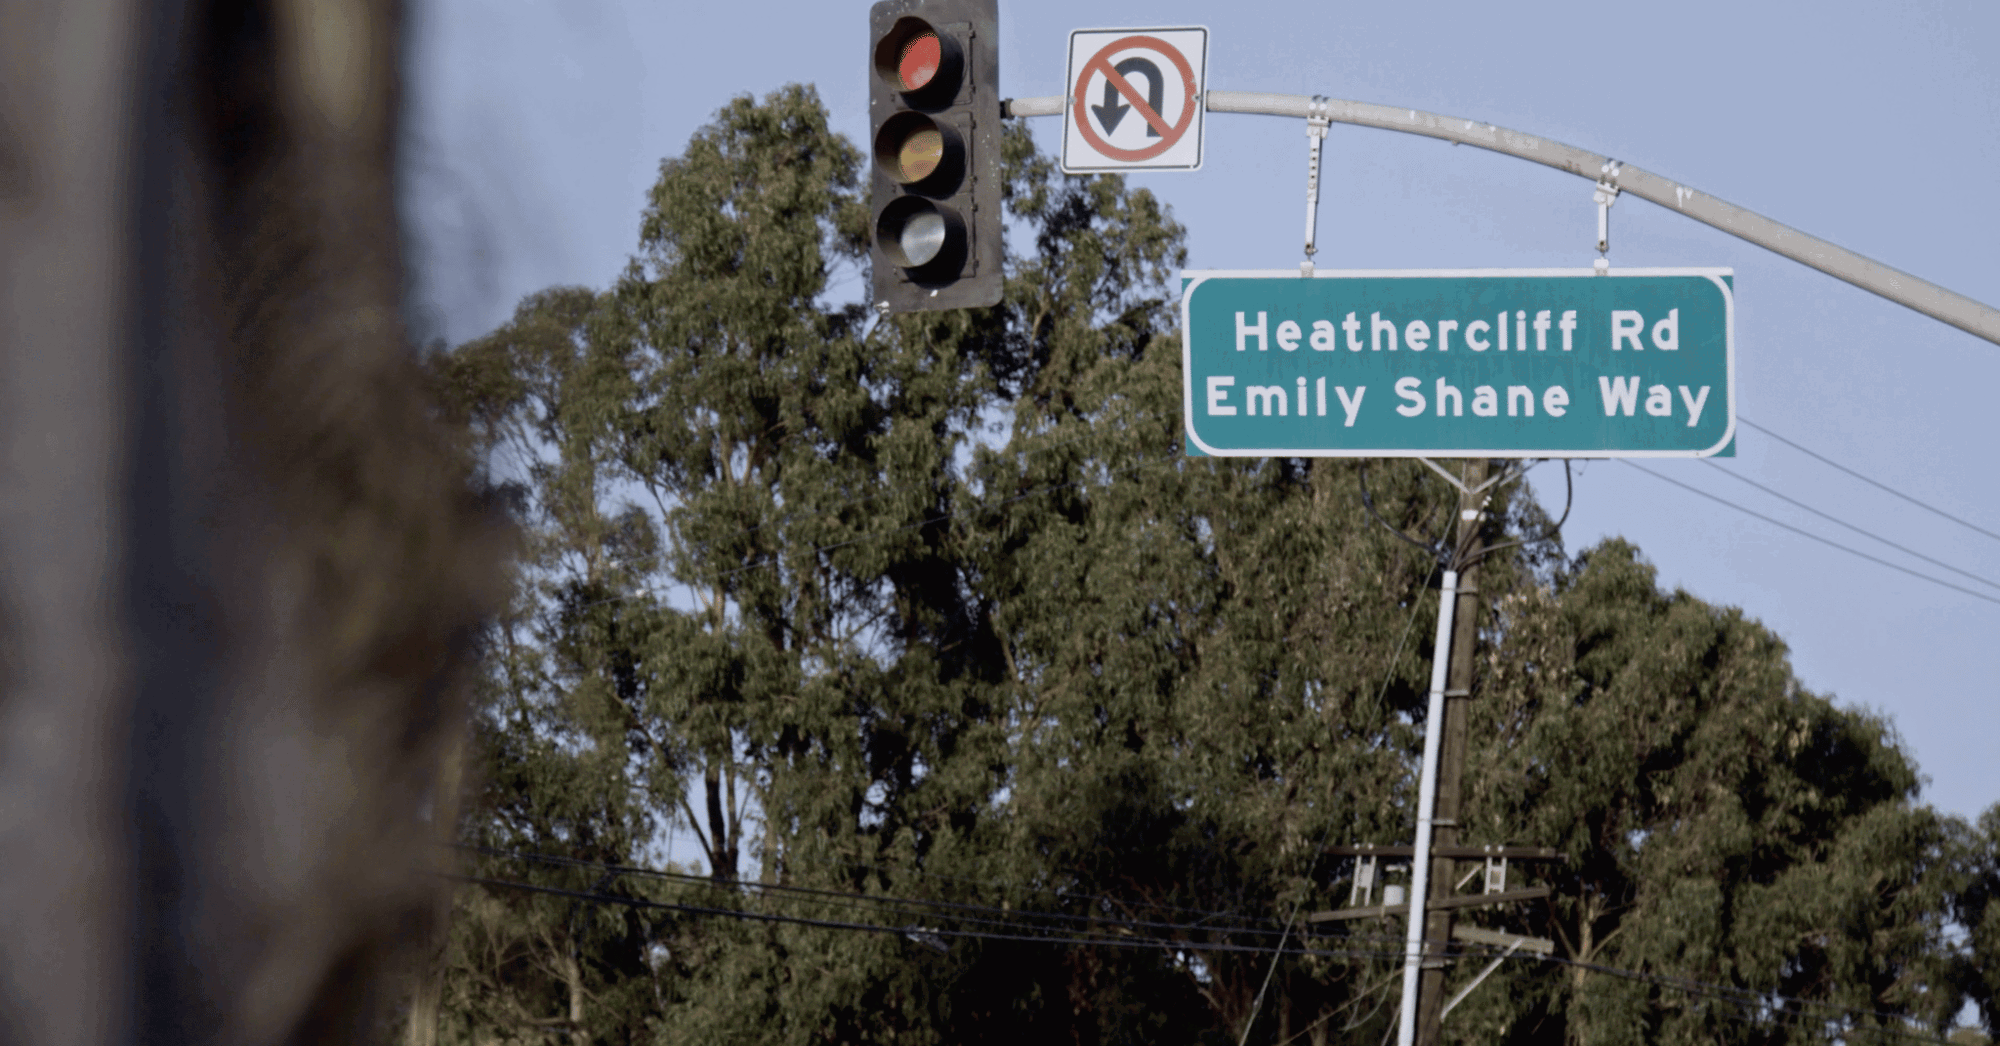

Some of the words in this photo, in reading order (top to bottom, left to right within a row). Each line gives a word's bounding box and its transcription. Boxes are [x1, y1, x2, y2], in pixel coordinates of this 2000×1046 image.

[1235, 309, 1578, 352] Heathercliff
[1611, 308, 1680, 351] Rd
[1206, 376, 1367, 427] Emily
[1395, 376, 1570, 417] Shane
[1598, 376, 1711, 427] Way
